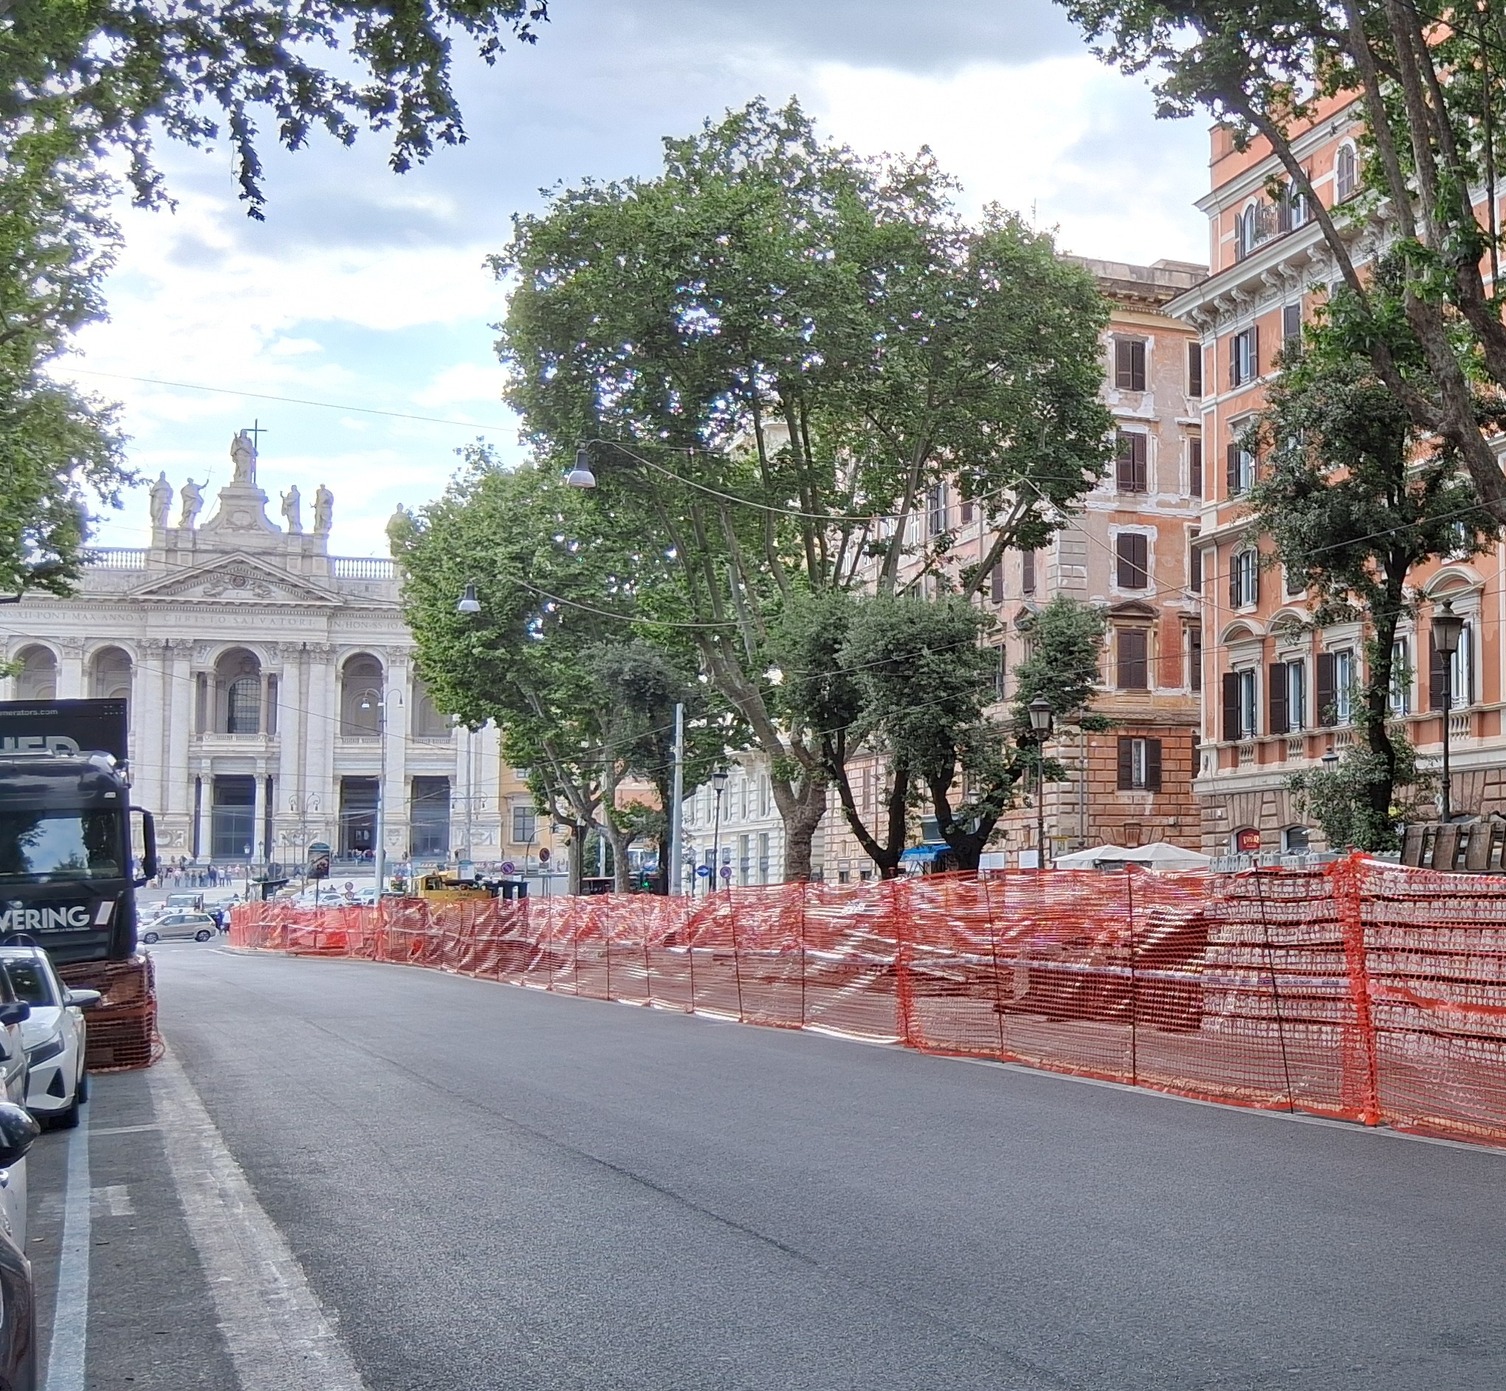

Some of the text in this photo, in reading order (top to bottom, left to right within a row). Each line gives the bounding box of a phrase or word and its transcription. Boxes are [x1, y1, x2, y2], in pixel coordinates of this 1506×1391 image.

[72, 612, 97, 621] MAX
[102, 612, 133, 621] ANNO
[163, 614, 227, 624] CHRISTO
